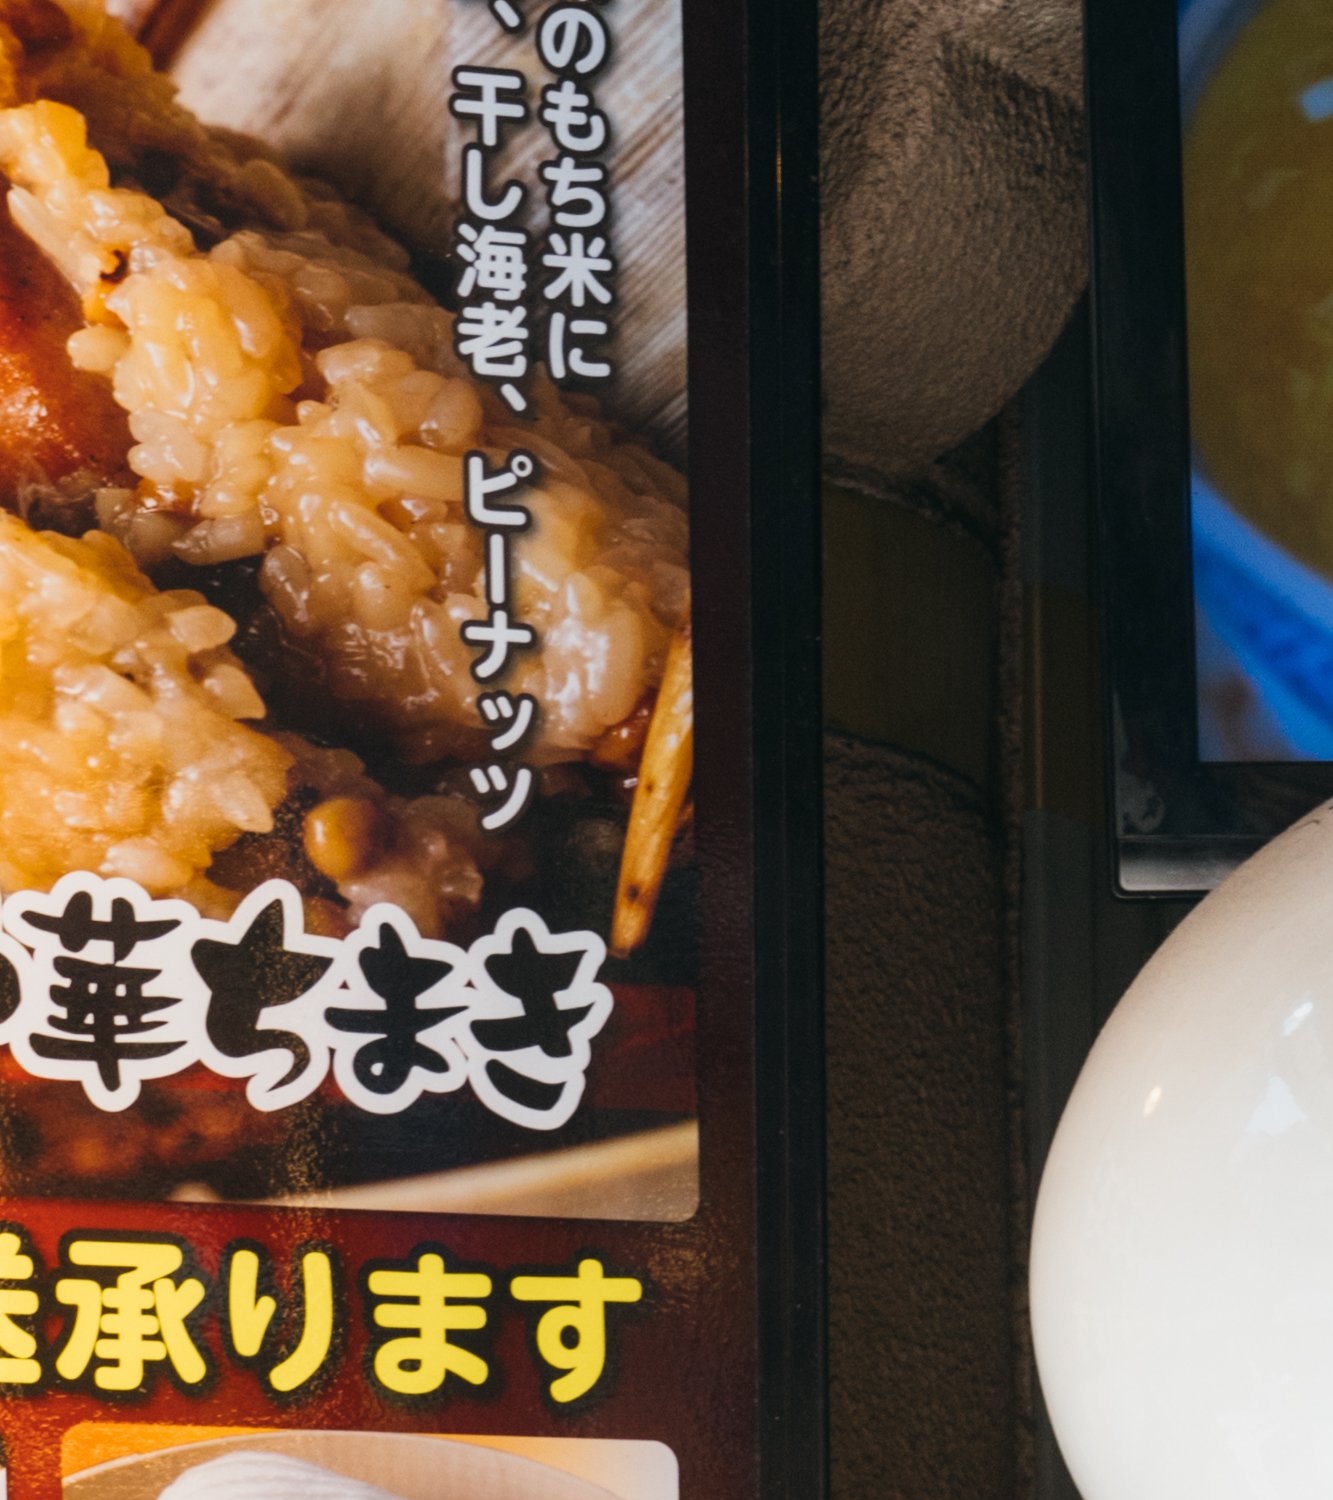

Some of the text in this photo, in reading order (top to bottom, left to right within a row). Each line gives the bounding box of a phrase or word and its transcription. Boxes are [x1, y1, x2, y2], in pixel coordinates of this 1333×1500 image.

[0, 884, 602, 1114] 華ちまき
[0, 1233, 643, 1403] 承ります
